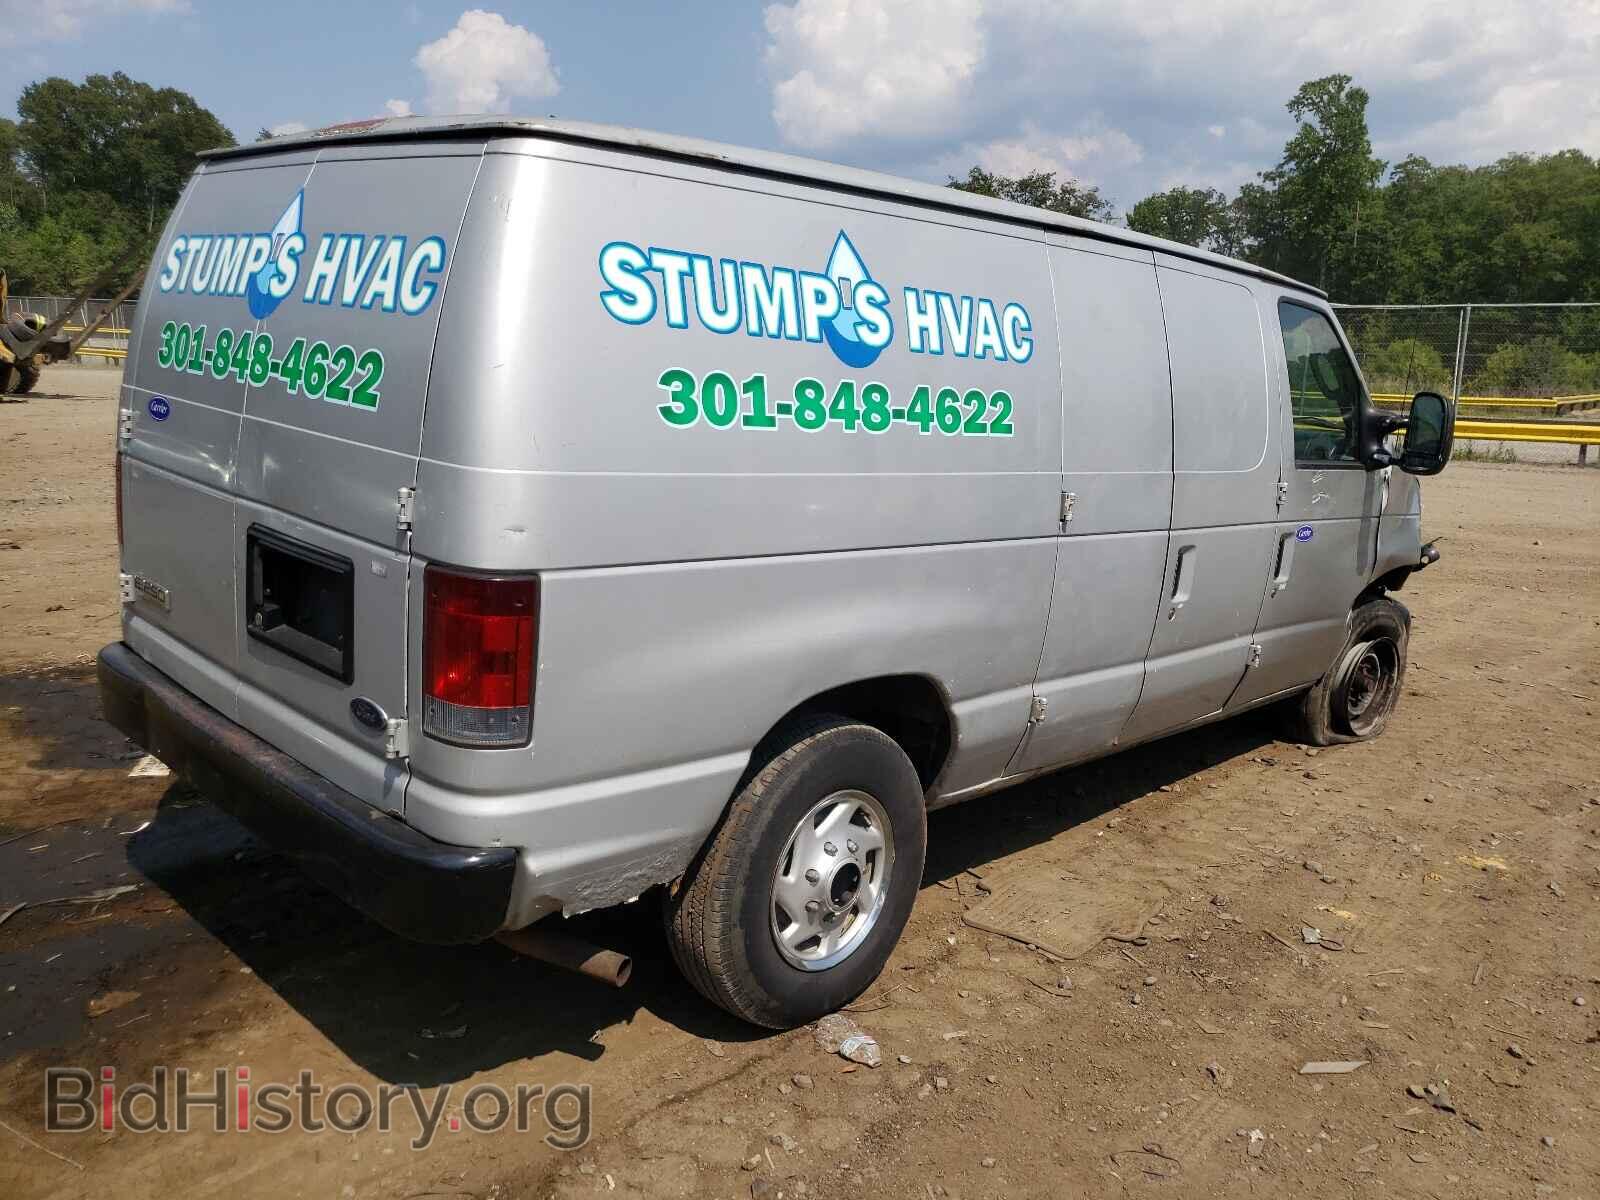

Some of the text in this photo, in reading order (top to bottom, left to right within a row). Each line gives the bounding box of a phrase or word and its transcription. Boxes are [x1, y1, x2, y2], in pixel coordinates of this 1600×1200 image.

[302, 233, 446, 316] HVAC
[903, 287, 1034, 364] HVAC
[158, 320, 385, 412] 301-848-4622
[657, 368, 1015, 437] 301-848-4622
